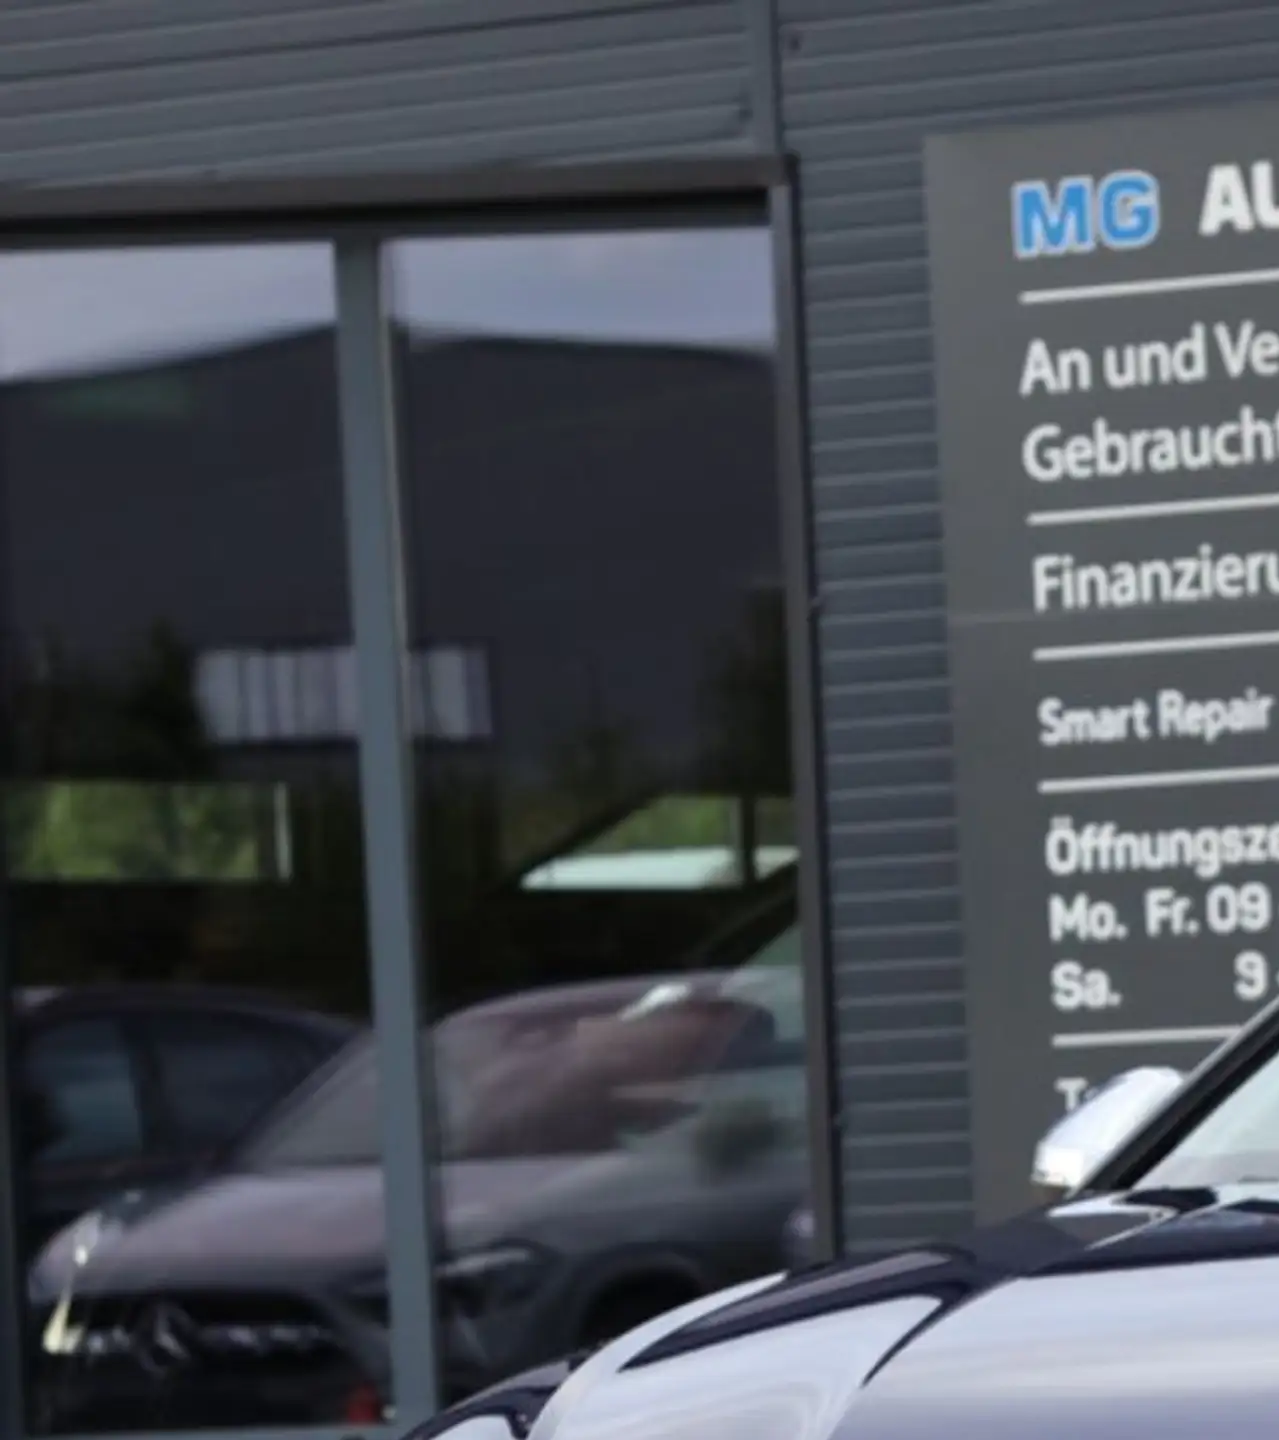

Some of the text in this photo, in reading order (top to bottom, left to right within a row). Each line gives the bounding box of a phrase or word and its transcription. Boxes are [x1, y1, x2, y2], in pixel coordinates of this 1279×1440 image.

[1011, 171, 1160, 257] MG
[1020, 340, 1091, 396] An
[1104, 324, 1206, 387] und
[1038, 686, 1275, 747] Smart Repair
[1049, 892, 1128, 942] Mo.
[1144, 885, 1199, 937] Fr.
[1206, 881, 1271, 934] 09
[1051, 961, 1122, 1010] Sa.
